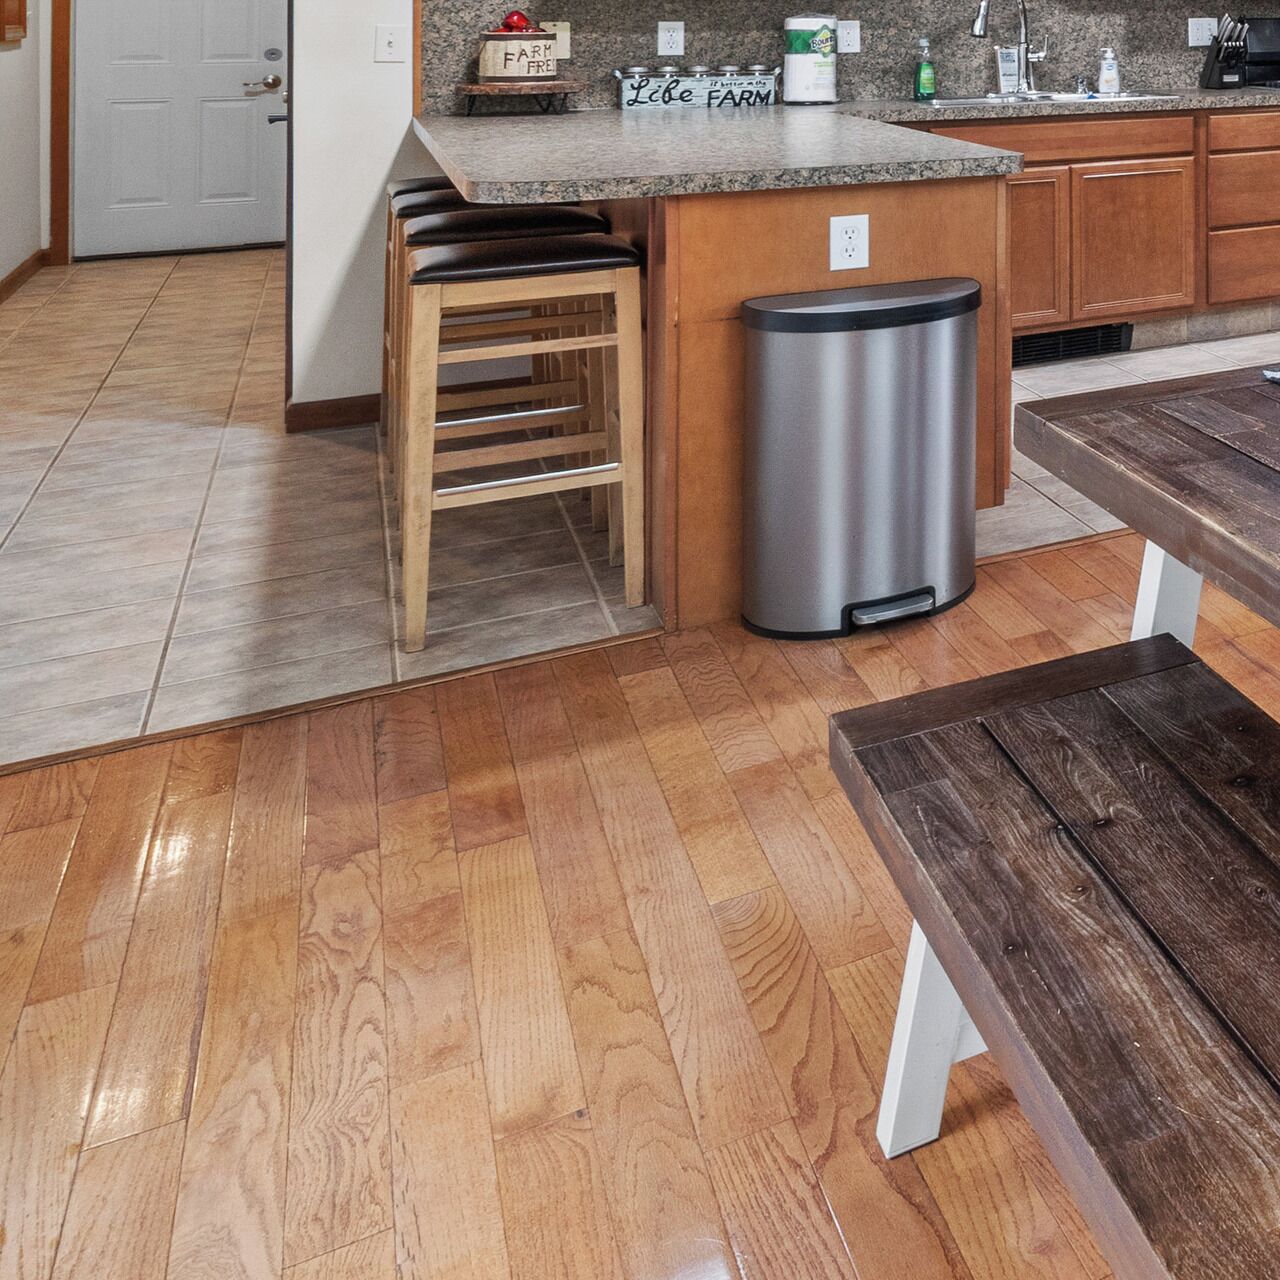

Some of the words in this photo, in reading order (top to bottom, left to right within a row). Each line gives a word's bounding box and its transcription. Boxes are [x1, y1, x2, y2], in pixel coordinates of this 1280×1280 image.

[811, 35, 834, 49] Bount
[503, 43, 552, 70] FARM
[526, 58, 555, 74] FRE
[626, 77, 694, 107] Life
[707, 88, 772, 108] FARM
